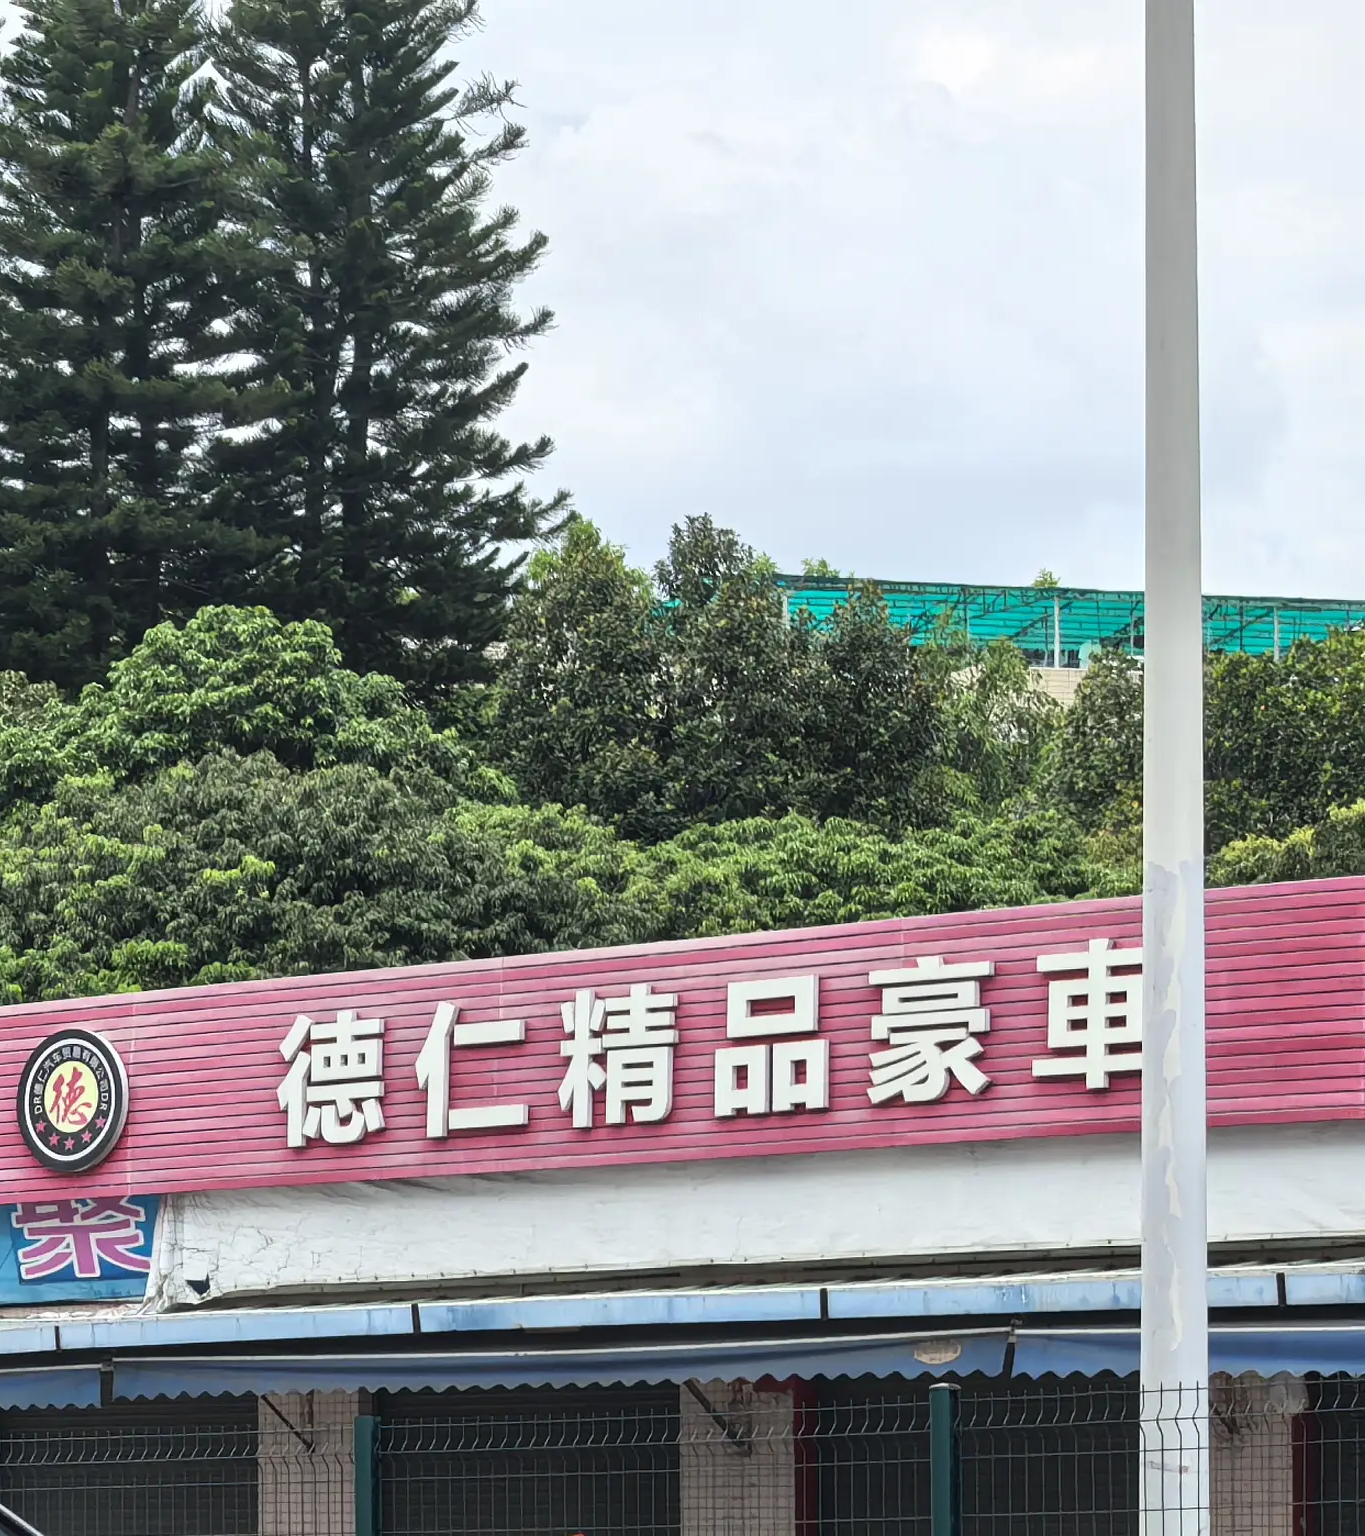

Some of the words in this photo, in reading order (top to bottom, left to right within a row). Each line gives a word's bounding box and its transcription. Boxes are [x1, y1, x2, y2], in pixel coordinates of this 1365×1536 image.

[276, 937, 1142, 1148] 德仁精品豪車
